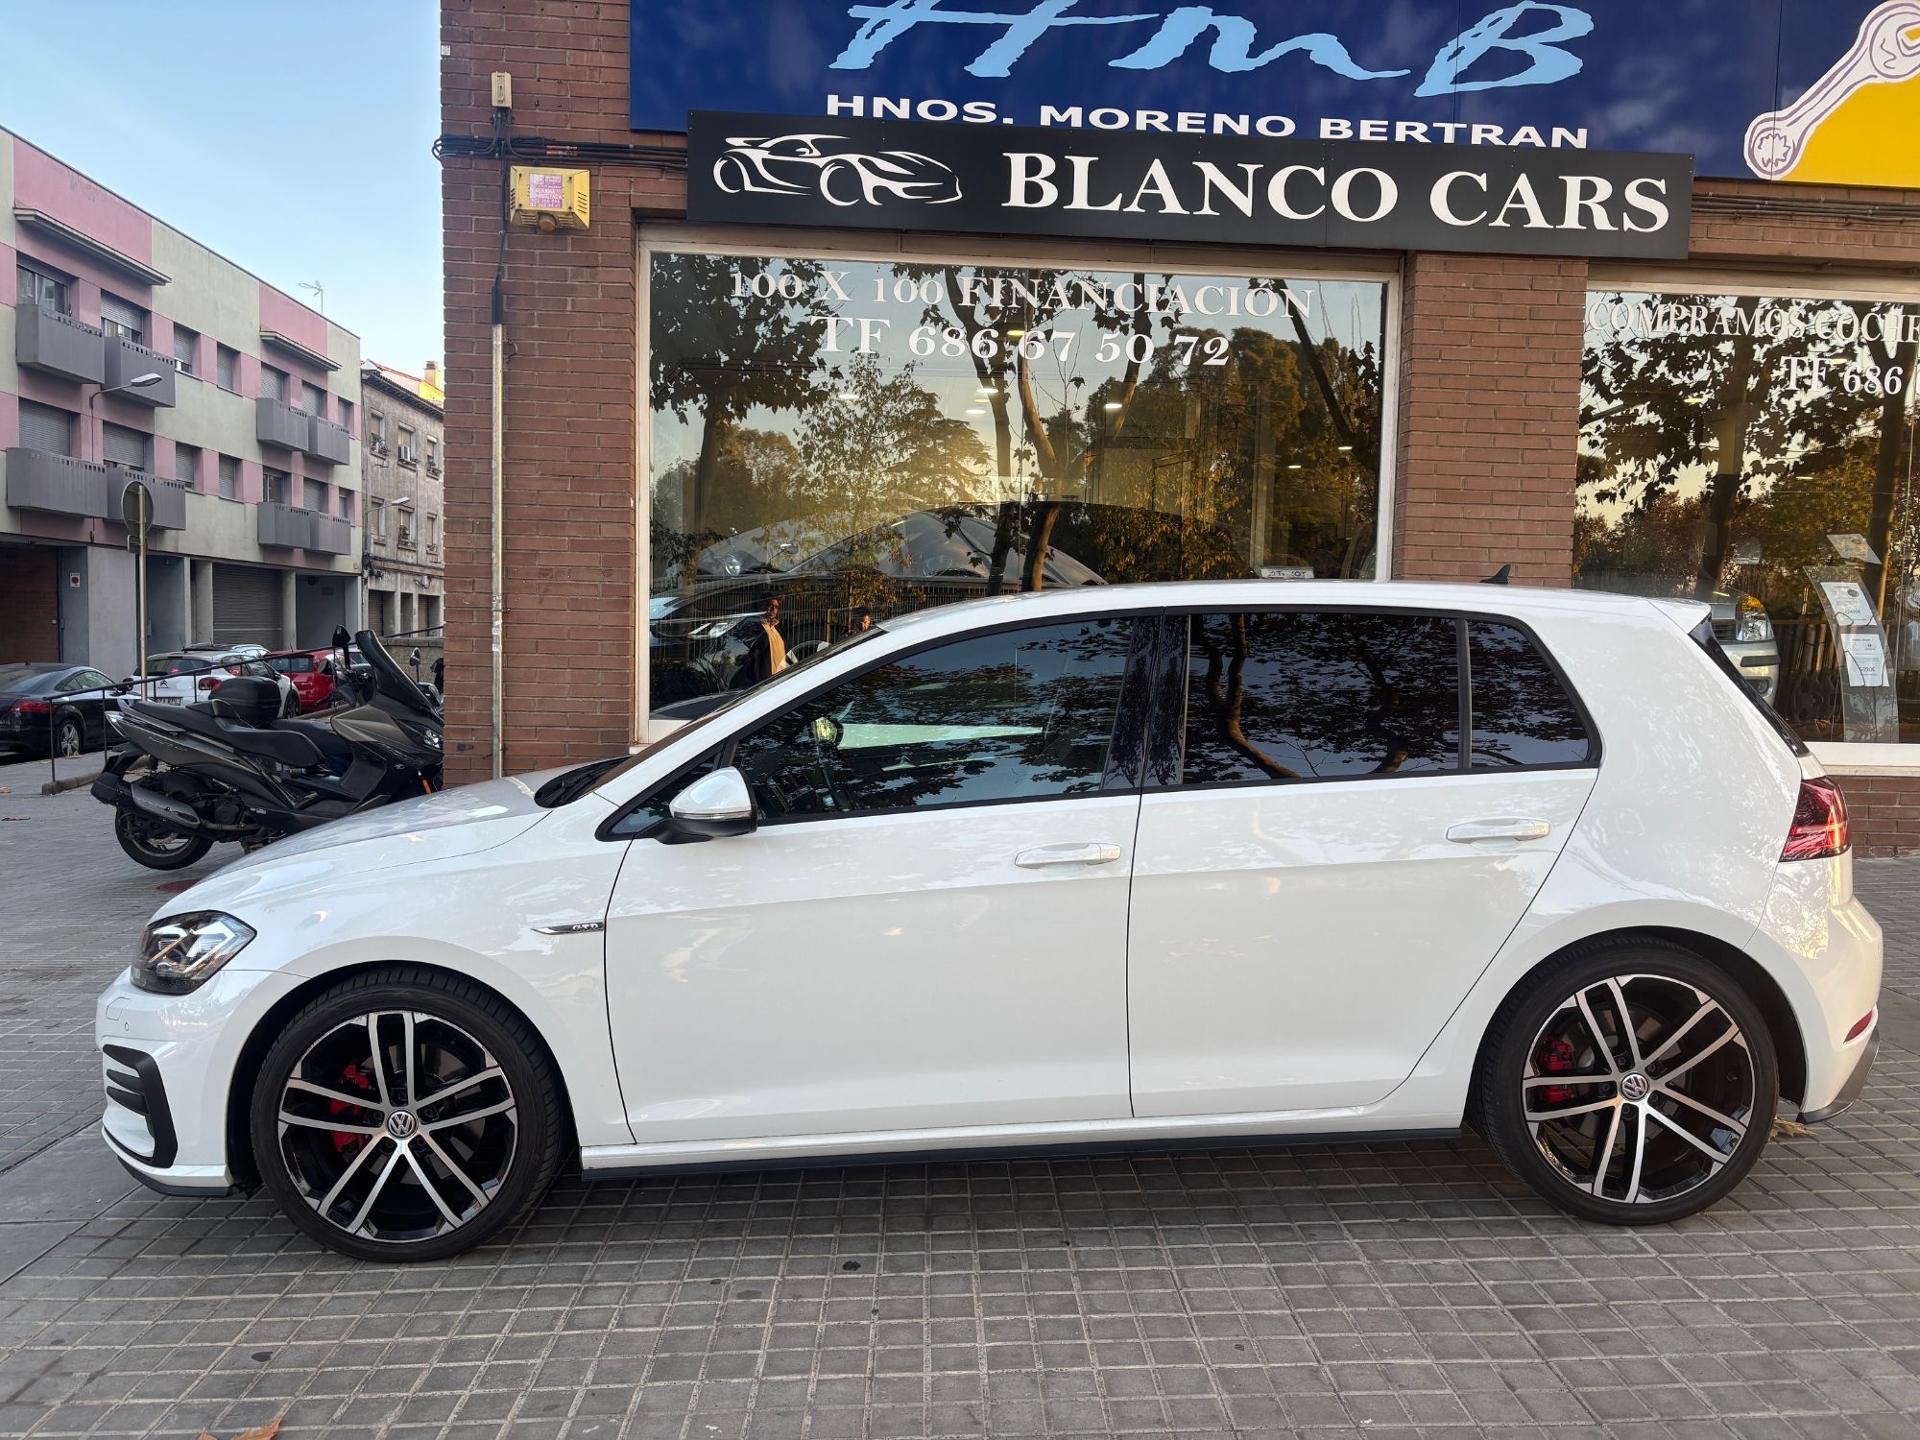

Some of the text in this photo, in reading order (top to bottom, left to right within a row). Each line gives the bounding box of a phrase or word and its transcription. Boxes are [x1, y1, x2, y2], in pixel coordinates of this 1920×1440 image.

[827, 94, 1588, 149] HNOS. MORENO BERTRAN
[1001, 152, 1670, 233] BLANCO CARS
[730, 271, 1314, 319] 100 X 100 FINANCIACIÓN
[1588, 301, 1806, 338] COMPRAMOS
[810, 315, 1230, 367] TF 686 67 50 72
[1780, 355, 1832, 392] TF
[1843, 365, 1904, 395] 686
